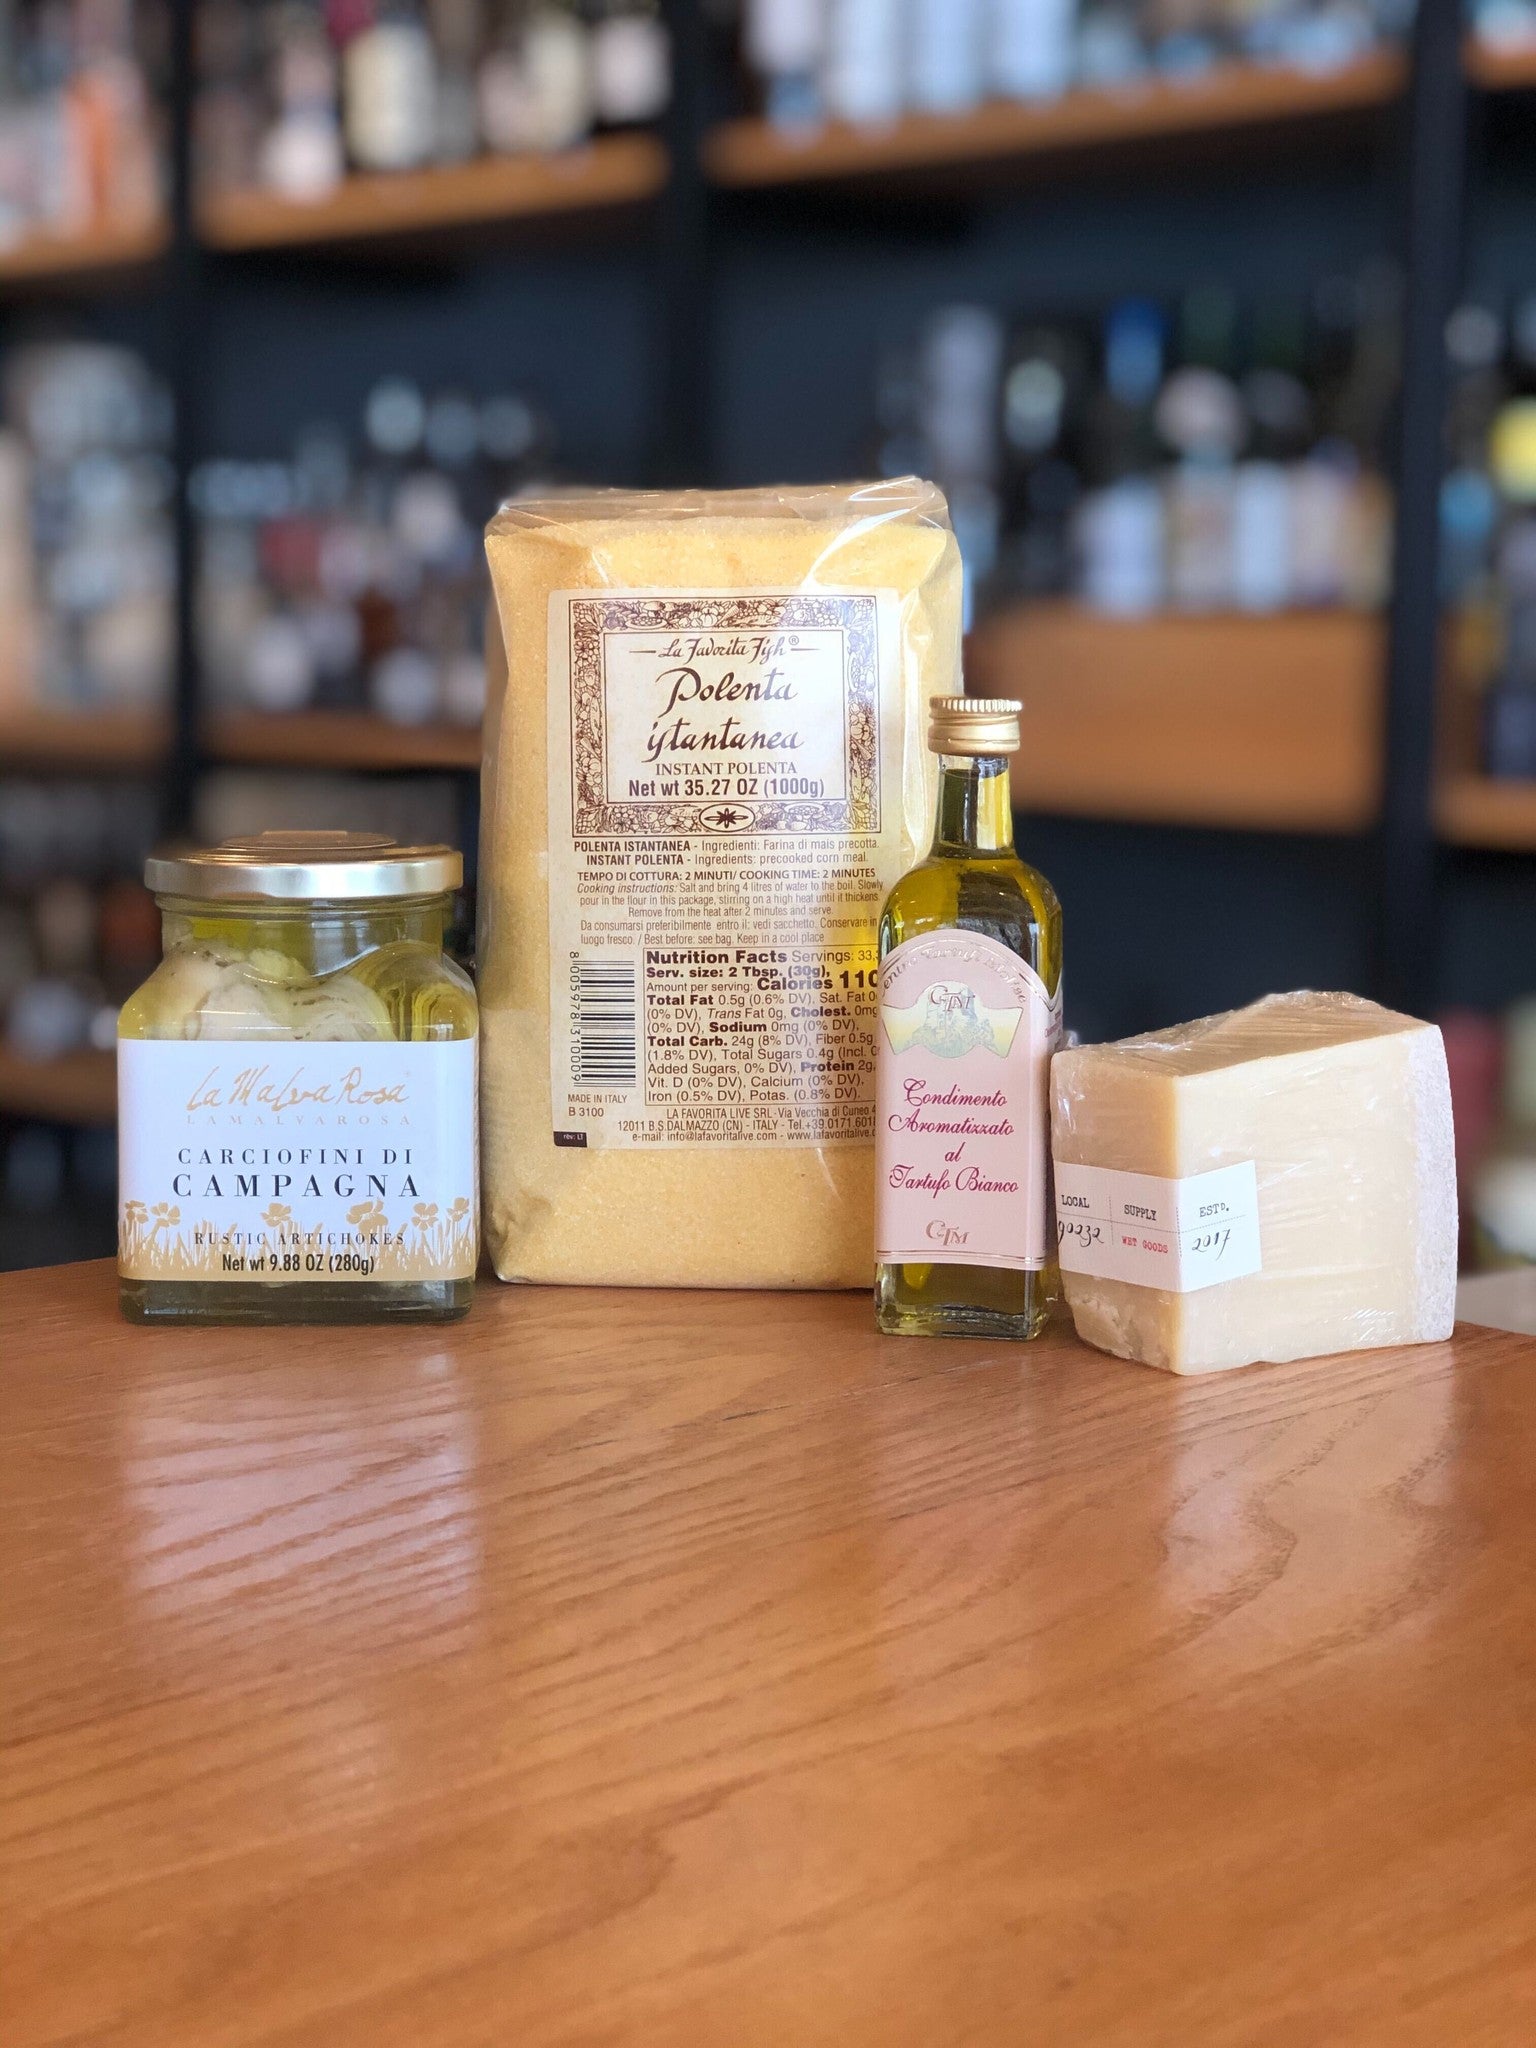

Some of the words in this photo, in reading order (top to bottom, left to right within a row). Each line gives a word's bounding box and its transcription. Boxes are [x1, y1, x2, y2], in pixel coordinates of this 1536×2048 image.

[658, 638, 684, 658] La
[683, 637, 748, 665] Favorita
[656, 667, 798, 718] Polenta
[656, 763, 723, 775] INSTANT
[728, 762, 797, 774] POLENTA
[629, 780, 656, 796] Net
[660, 781, 680, 796] wt
[684, 779, 733, 796] 35.27
[736, 778, 758, 796] OZ
[764, 778, 824, 798] (1000g)
[574, 841, 621, 851] POLENTA
[624, 840, 690, 851] ISTANTANEA
[702, 839, 760, 853] Ingredienti:
[764, 839, 794, 850] Farina
[798, 839, 808, 849] di
[810, 839, 835, 849] mais
[838, 838, 880, 851] precotta.
[586, 854, 630, 865] INSTANT
[634, 854, 684, 865] POLENTA
[695, 853, 756, 867] Ingredients:
[760, 852, 813, 866] precooked
[816, 854, 839, 863] corn
[842, 851, 868, 862] meal.
[577, 871, 613, 881] TEMPO
[616, 871, 626, 881] DI
[629, 870, 682, 881] COTTURA:
[685, 870, 691, 880] 2
[694, 870, 738, 881] MINUTI/
[739, 869, 790, 879] COOKING
[792, 869, 820, 878] TIME:
[822, 869, 829, 878] 2
[831, 868, 876, 878] MINUTES
[646, 951, 729, 964] Nutrition
[735, 950, 787, 963] Facts
[792, 950, 854, 965] Servings:
[646, 967, 684, 978] Serv.
[689, 966, 723, 977] size:
[728, 966, 737, 977] 2
[742, 966, 783, 980] Tbsp.
[788, 965, 830, 979] (30g),
[646, 982, 687, 991] Amount
[690, 984, 707, 993] per
[711, 982, 753, 993] serving:
[758, 978, 832, 990] Calories
[840, 970, 878, 988] 110
[647, 994, 684, 1005] Total
[690, 994, 713, 1005] Fat
[718, 993, 745, 1007] 0.5g
[749, 992, 784, 1005] (0.6%
[819, 992, 842, 1003] Sat.
[847, 992, 865, 1002] Fat
[647, 1008, 671, 1021] (0%
[675, 1008, 702, 1020] DV),
[708, 1007, 741, 1018] Trans
[745, 1007, 764, 1018] Fat
[791, 1006, 850, 1017] Cholest.
[647, 1022, 672, 1034] (0%
[676, 1021, 704, 1034] DV),
[709, 1021, 767, 1032] Sodium
[771, 1020, 798, 1033] 0mg
[803, 1020, 828, 1032] (0%
[647, 1036, 684, 1046] Total
[689, 1035, 727, 1046] Carb.
[731, 1035, 754, 1048] 24g
[758, 1034, 782, 1046] (8%
[816, 1033, 845, 1044] Fiber
[849, 1033, 873, 1046] 0.5g
[647, 1049, 684, 1062] (1.8%
[724, 1048, 753, 1059] Total
[757, 1048, 801, 1061] Sugars
[806, 1047, 833, 1060] 0.4g
[838, 1046, 868, 1059] (Incl.
[648, 1063, 688, 1074] Added
[692, 1063, 740, 1075] Sugars,
[744, 1062, 764, 1072] 0%
[769, 1061, 796, 1074] DV),
[800, 1061, 854, 1072] Protein
[186, 1065, 222, 1111] La
[228, 1064, 336, 1112] Malva
[335, 1066, 410, 1105] Rosa
[648, 1077, 668, 1088] Vit.
[673, 1077, 683, 1087] D
[688, 1076, 713, 1089] (0%
[718, 1076, 746, 1088] DV),
[751, 1075, 803, 1086] Calcium
[808, 1074, 833, 1087] (0%
[567, 1094, 591, 1103] MADE
[593, 1094, 602, 1103] IN
[605, 1094, 628, 1103] ITALY
[648, 1091, 672, 1102] Iron
[676, 1090, 713, 1103] (0.5%
[717, 1090, 745, 1102] DV),
[750, 1090, 789, 1100] Potas.
[794, 1089, 830, 1101] (0.8%
[834, 1088, 861, 1101] DV).
[904, 1078, 1007, 1106] Condimento
[568, 1107, 576, 1117] B
[579, 1107, 604, 1117] 3100
[666, 1109, 678, 1119] LA
[681, 1108, 727, 1119] FAVORITA
[730, 1107, 750, 1118] LIVE
[753, 1107, 772, 1117] SRL
[778, 1107, 792, 1117] Via
[794, 1106, 829, 1116] Vecchia
[832, 1106, 839, 1115] di
[842, 1105, 869, 1115] Cuneo
[186, 1115, 410, 1126] LAMALVAROSA
[618, 1121, 645, 1131] 12011
[722, 1119, 742, 1131] (CN)
[752, 1119, 778, 1129] ITALY
[888, 1108, 1014, 1136] Aromatizzato
[632, 1132, 664, 1141] e-mail:
[178, 1148, 364, 1164] CARCIOFINI
[382, 1148, 412, 1164] DI
[944, 1142, 966, 1162] al
[172, 1174, 420, 1197] CAMPAGNA
[889, 1164, 951, 1198] Tartufo
[956, 1166, 1018, 1193] Bianco
[1062, 1194, 1090, 1208] LOCAL
[1124, 1204, 1156, 1220] SUPPLY
[1200, 1202, 1229, 1218] ESTD.
[194, 1232, 266, 1244] RUSTIC
[278, 1232, 405, 1244] ARTICHOKES
[1122, 1236, 1138, 1246] WET
[1143, 1240, 1168, 1254] GOODS
[1192, 1229, 1230, 1260] 2017
[222, 1254, 244, 1271] Net
[250, 1257, 264, 1271] wt
[270, 1254, 300, 1271] 9.88
[306, 1254, 324, 1271] OZ
[328, 1254, 374, 1275] (280g)
